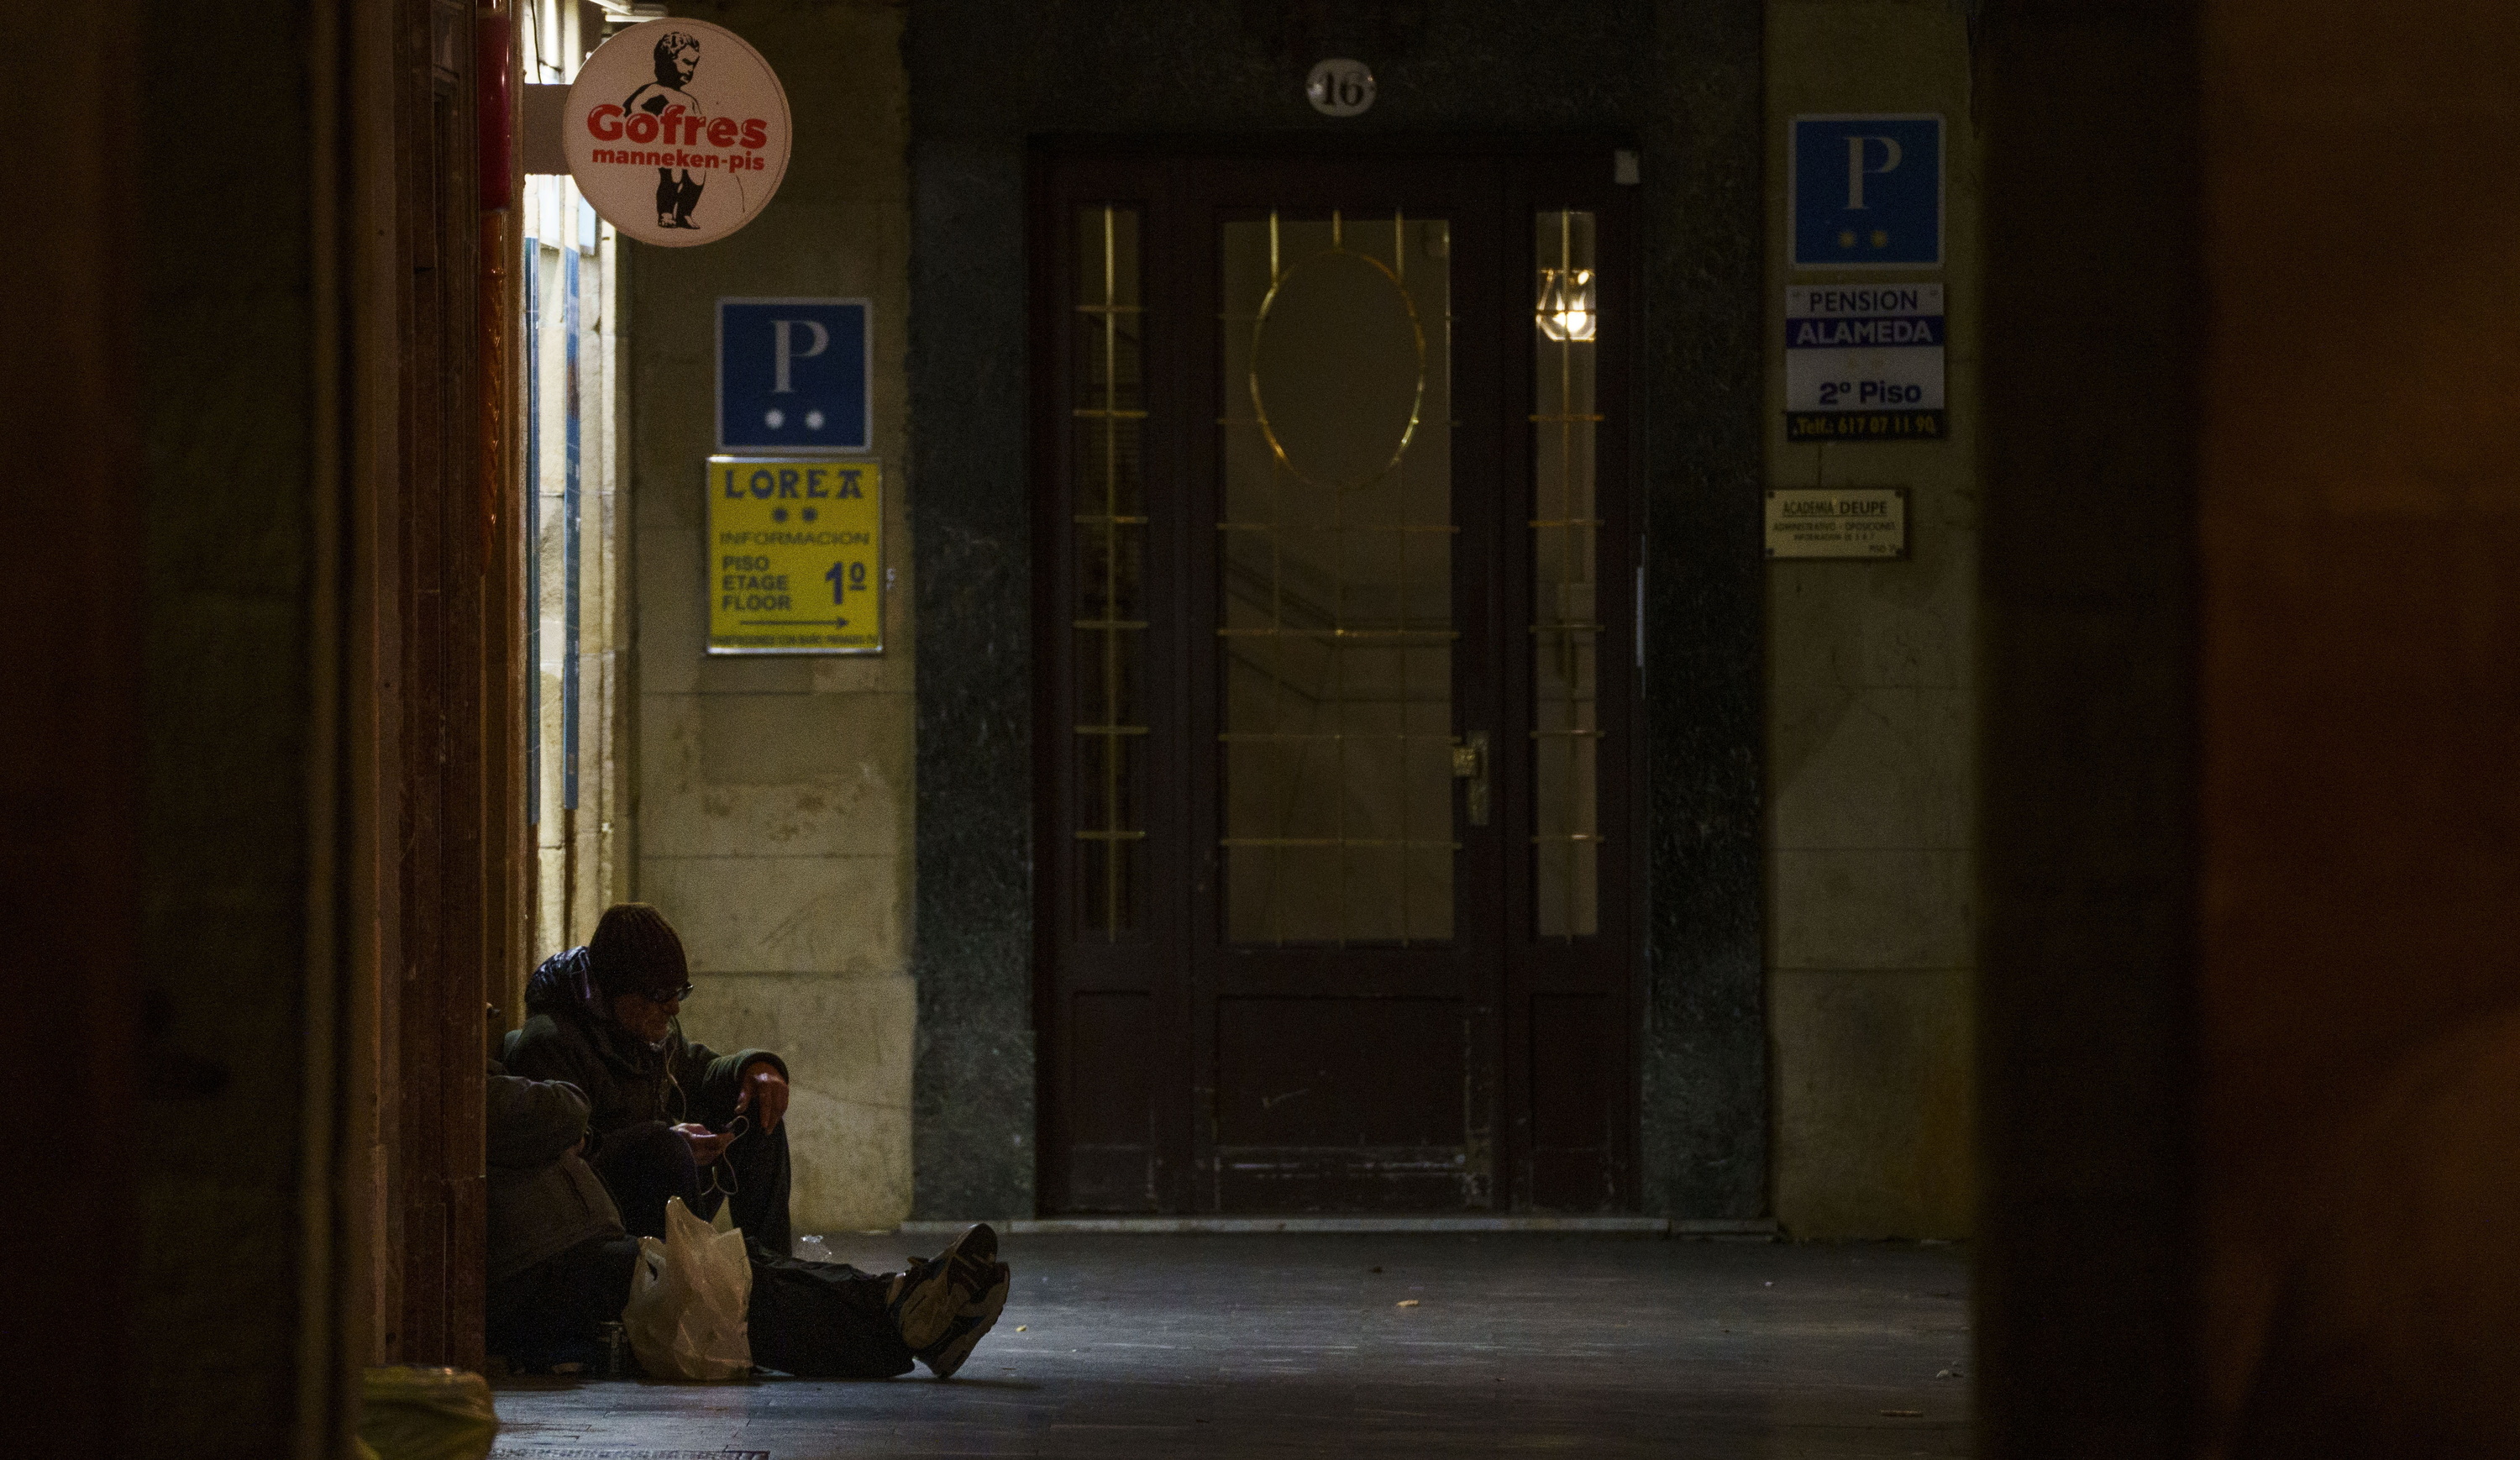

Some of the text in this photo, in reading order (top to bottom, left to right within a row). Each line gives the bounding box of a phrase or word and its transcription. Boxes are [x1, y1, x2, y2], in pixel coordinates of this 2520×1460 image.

[1321, 71, 1364, 107] 16
[587, 103, 768, 150] Gofres
[591, 149, 764, 173] manneken-pis
[1844, 136, 1903, 210] P
[1809, 290, 1918, 312] PENSION
[1795, 319, 1934, 345] ALAMEDA
[769, 319, 830, 393] P
[1860, 380, 1922, 404] Piso
[724, 469, 864, 499] LOREA
[1783, 501, 1887, 514] ACADEMIA DEUPE
[720, 532, 870, 545] INFORMACION
[722, 555, 770, 572] PISO
[722, 575, 788, 591] ETAGE
[722, 595, 792, 611] FLOOR
